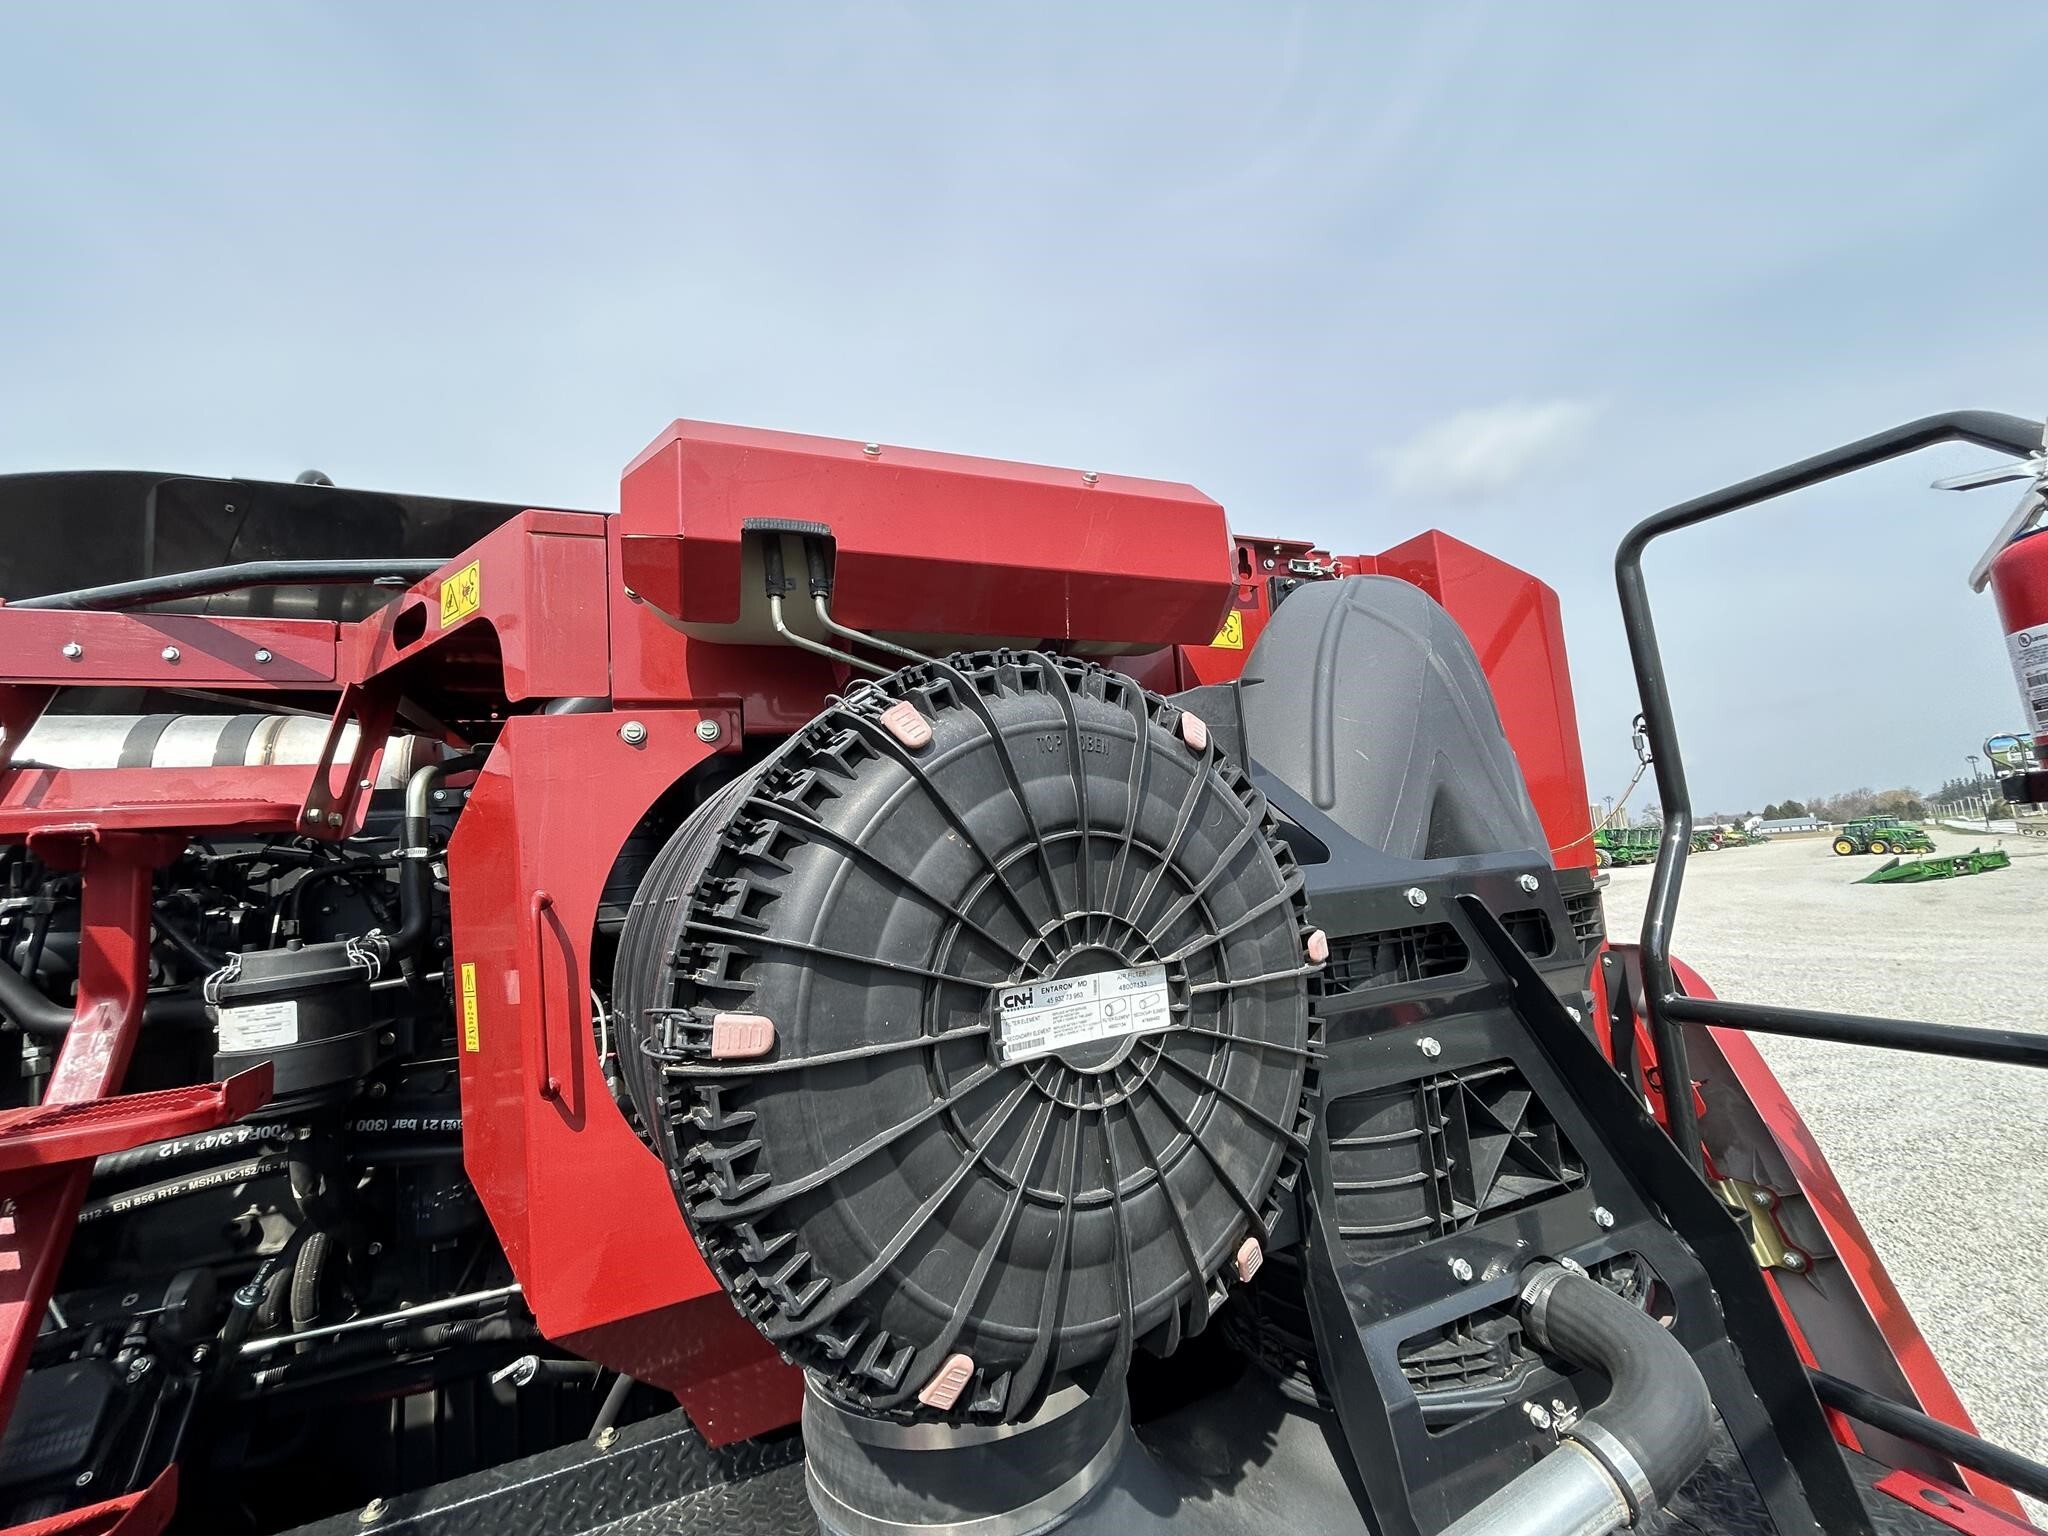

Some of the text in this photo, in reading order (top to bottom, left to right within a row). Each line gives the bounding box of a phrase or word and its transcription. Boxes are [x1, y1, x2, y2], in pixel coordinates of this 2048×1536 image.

[1040, 982, 1073, 995] ENTARON
[356, 1119, 388, 1132] (300
[392, 1118, 418, 1130] bar
[422, 1119, 439, 1131] 21
[78, 1208, 103, 1224] R12
[113, 1200, 132, 1212] EN
[134, 1194, 155, 1206] 856
[158, 1186, 180, 1200] R12
[188, 1174, 223, 1190] MSHA
[225, 1162, 272, 1182] IC-152/16
